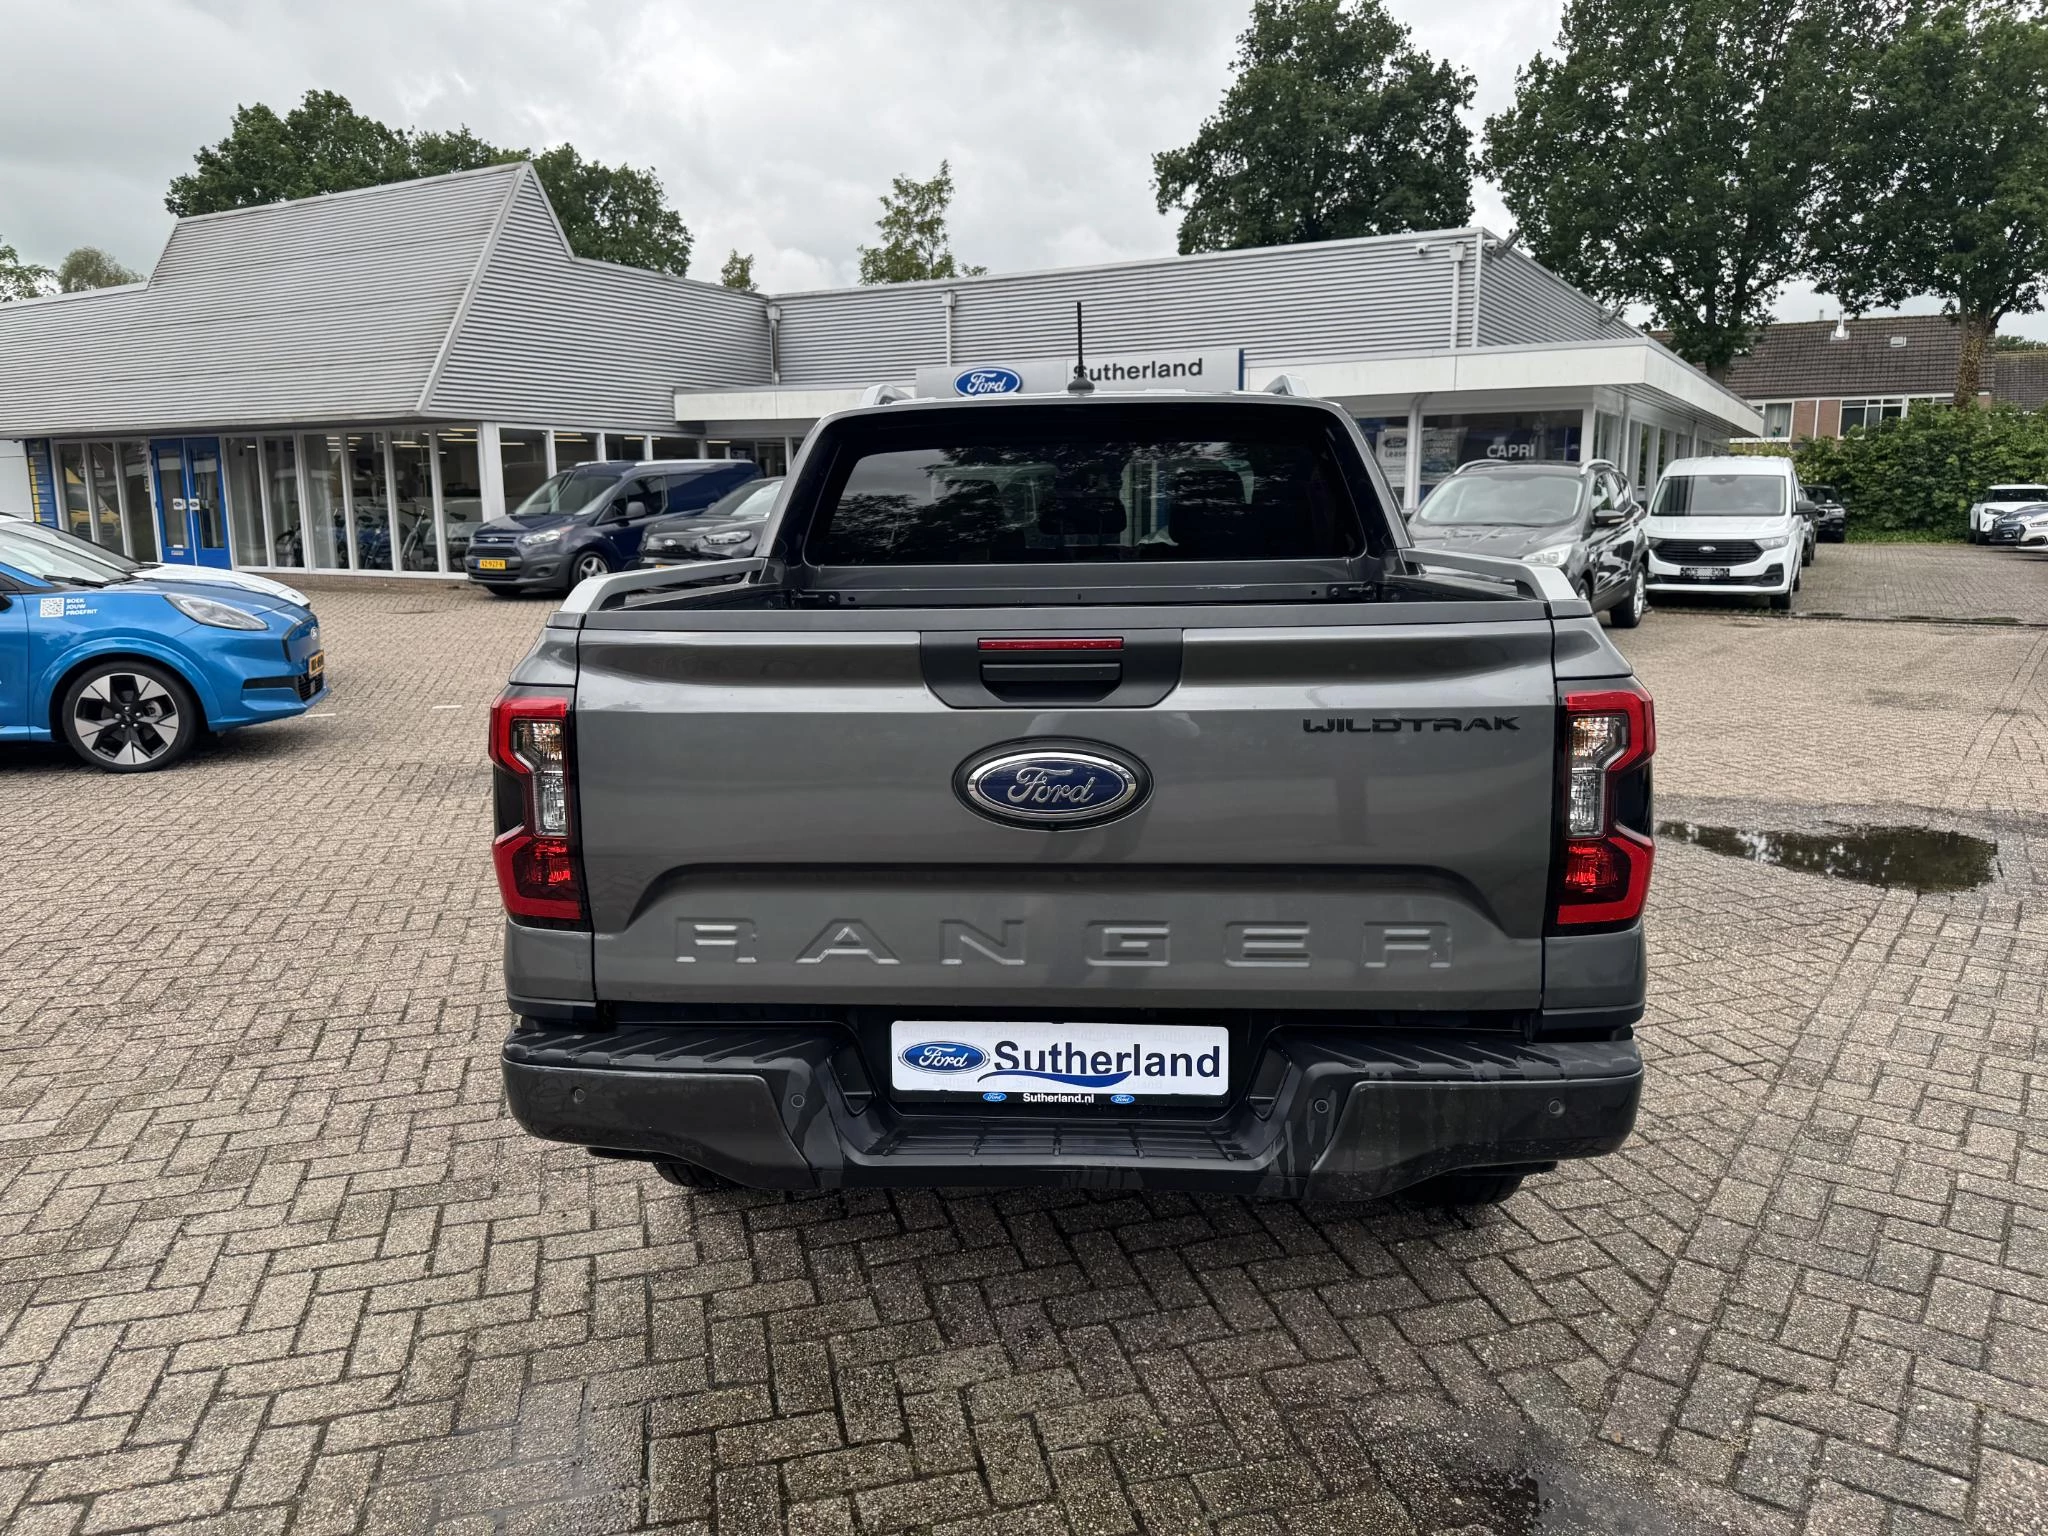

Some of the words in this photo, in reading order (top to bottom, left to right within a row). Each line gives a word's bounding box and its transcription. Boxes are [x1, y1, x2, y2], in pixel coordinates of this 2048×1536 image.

[966, 372, 1007, 393] Ford
[1486, 444, 1535, 458] CAPRI
[66, 608, 98, 616] PROEFRIT
[1303, 716, 1521, 733] WILDTRAK
[1007, 766, 1096, 803] Ford
[675, 917, 1453, 968] RANGER
[918, 1046, 968, 1068] Ford
[994, 1040, 1221, 1078] Sutherland
[1022, 1092, 1095, 1104] Sutherland.nl
